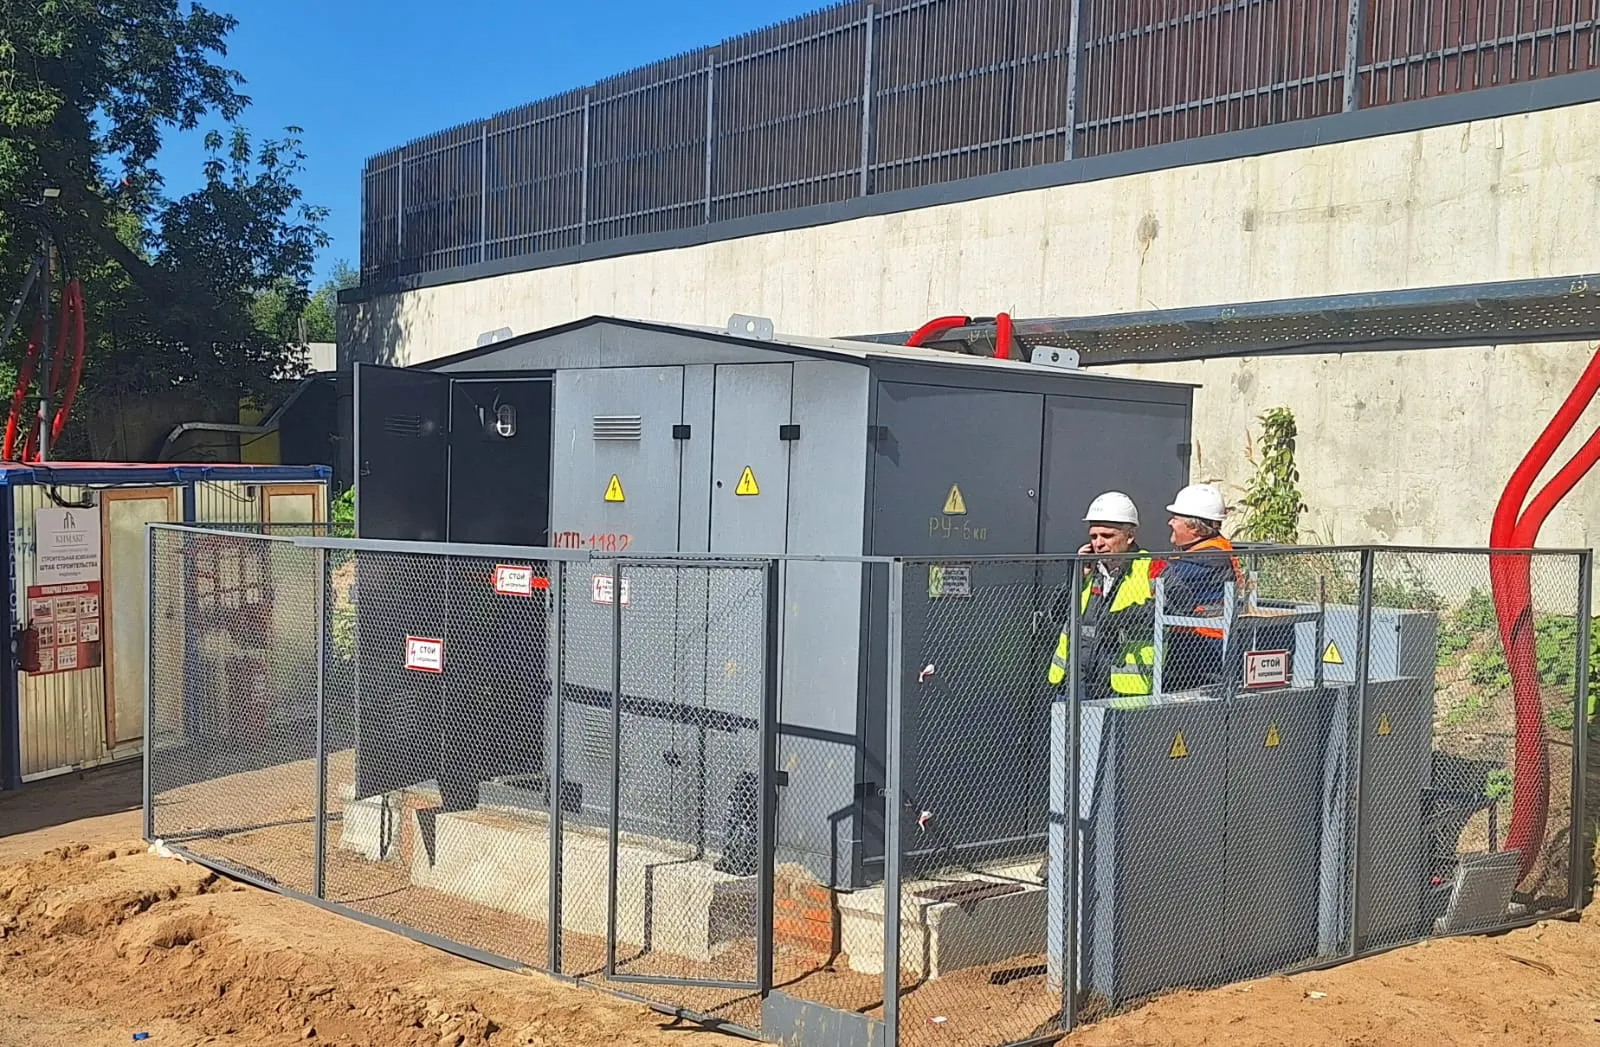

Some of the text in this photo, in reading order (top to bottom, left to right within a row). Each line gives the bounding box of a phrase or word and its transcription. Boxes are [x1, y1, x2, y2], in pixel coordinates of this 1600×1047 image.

[929, 516, 970, 540] РУ-6
[553, 531, 628, 552] КТП-1182
[1260, 655, 1281, 668] СТОЙ
